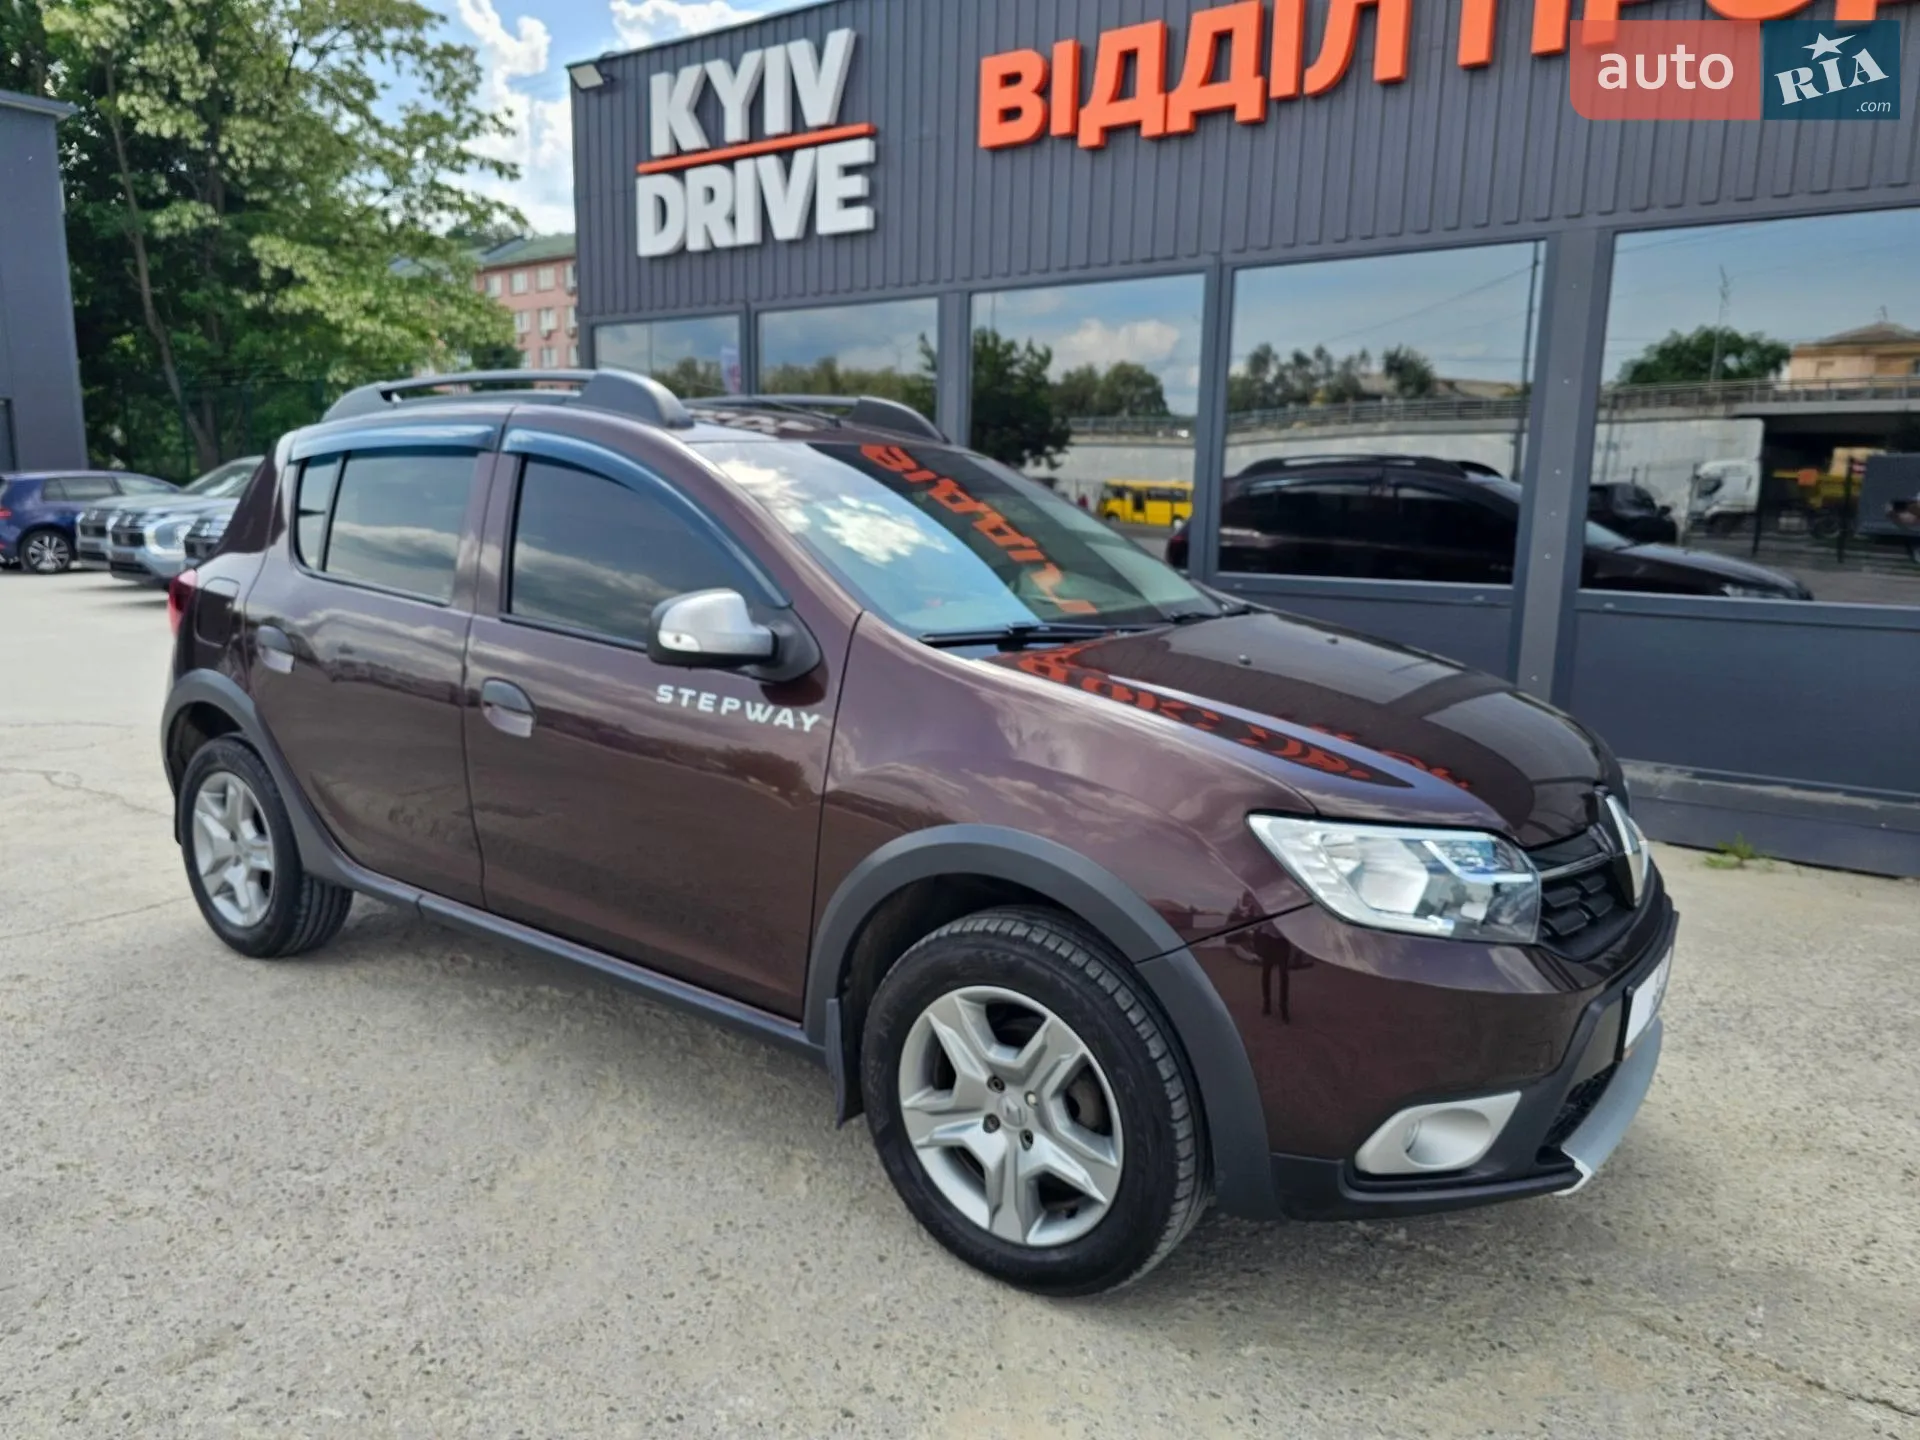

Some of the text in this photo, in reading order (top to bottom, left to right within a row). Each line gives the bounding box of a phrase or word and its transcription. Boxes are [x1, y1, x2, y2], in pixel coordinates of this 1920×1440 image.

[650, 27, 856, 158] KYIV
[978, 0, 1411, 149] ВІДДІЛ
[635, 138, 876, 257] DRIVE
[655, 684, 821, 733] STEPWAY
